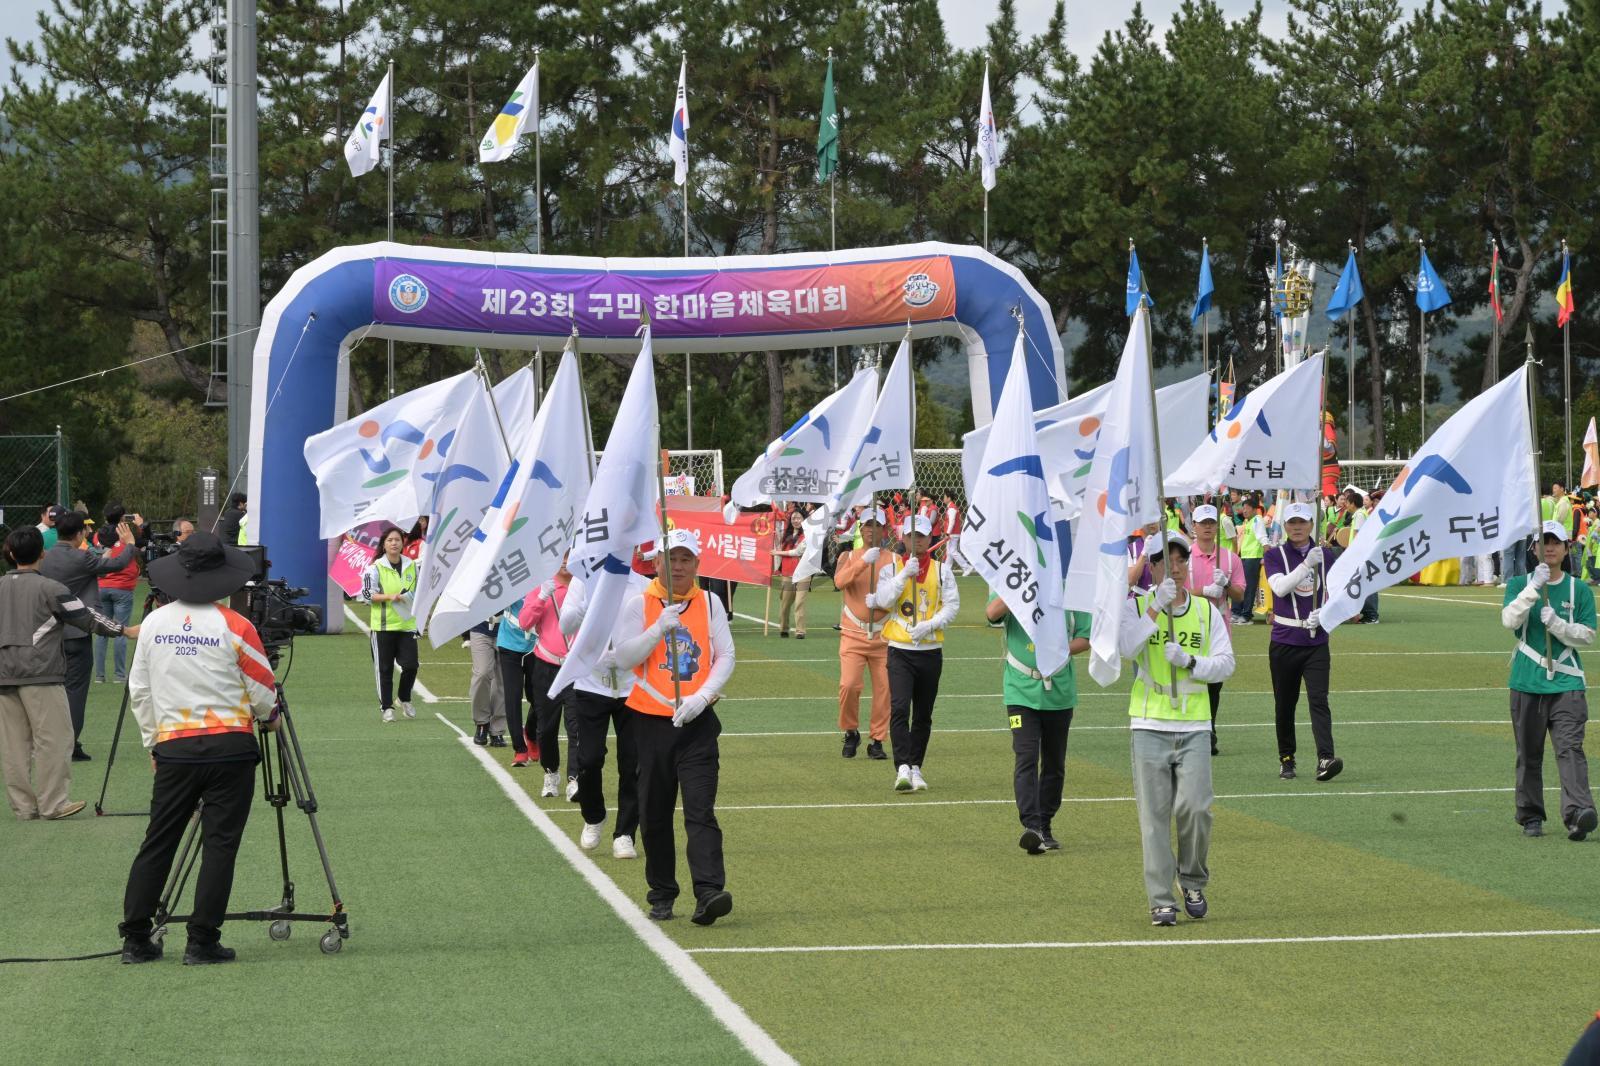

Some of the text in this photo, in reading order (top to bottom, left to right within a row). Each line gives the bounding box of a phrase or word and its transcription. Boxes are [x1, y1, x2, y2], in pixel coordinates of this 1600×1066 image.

[481, 285, 847, 320] 제23회 구민 한마음체육대회
[707, 533, 757, 561] 사람들
[154, 634, 220, 647] GYEONGNAM
[175, 646, 198, 656] 2025
